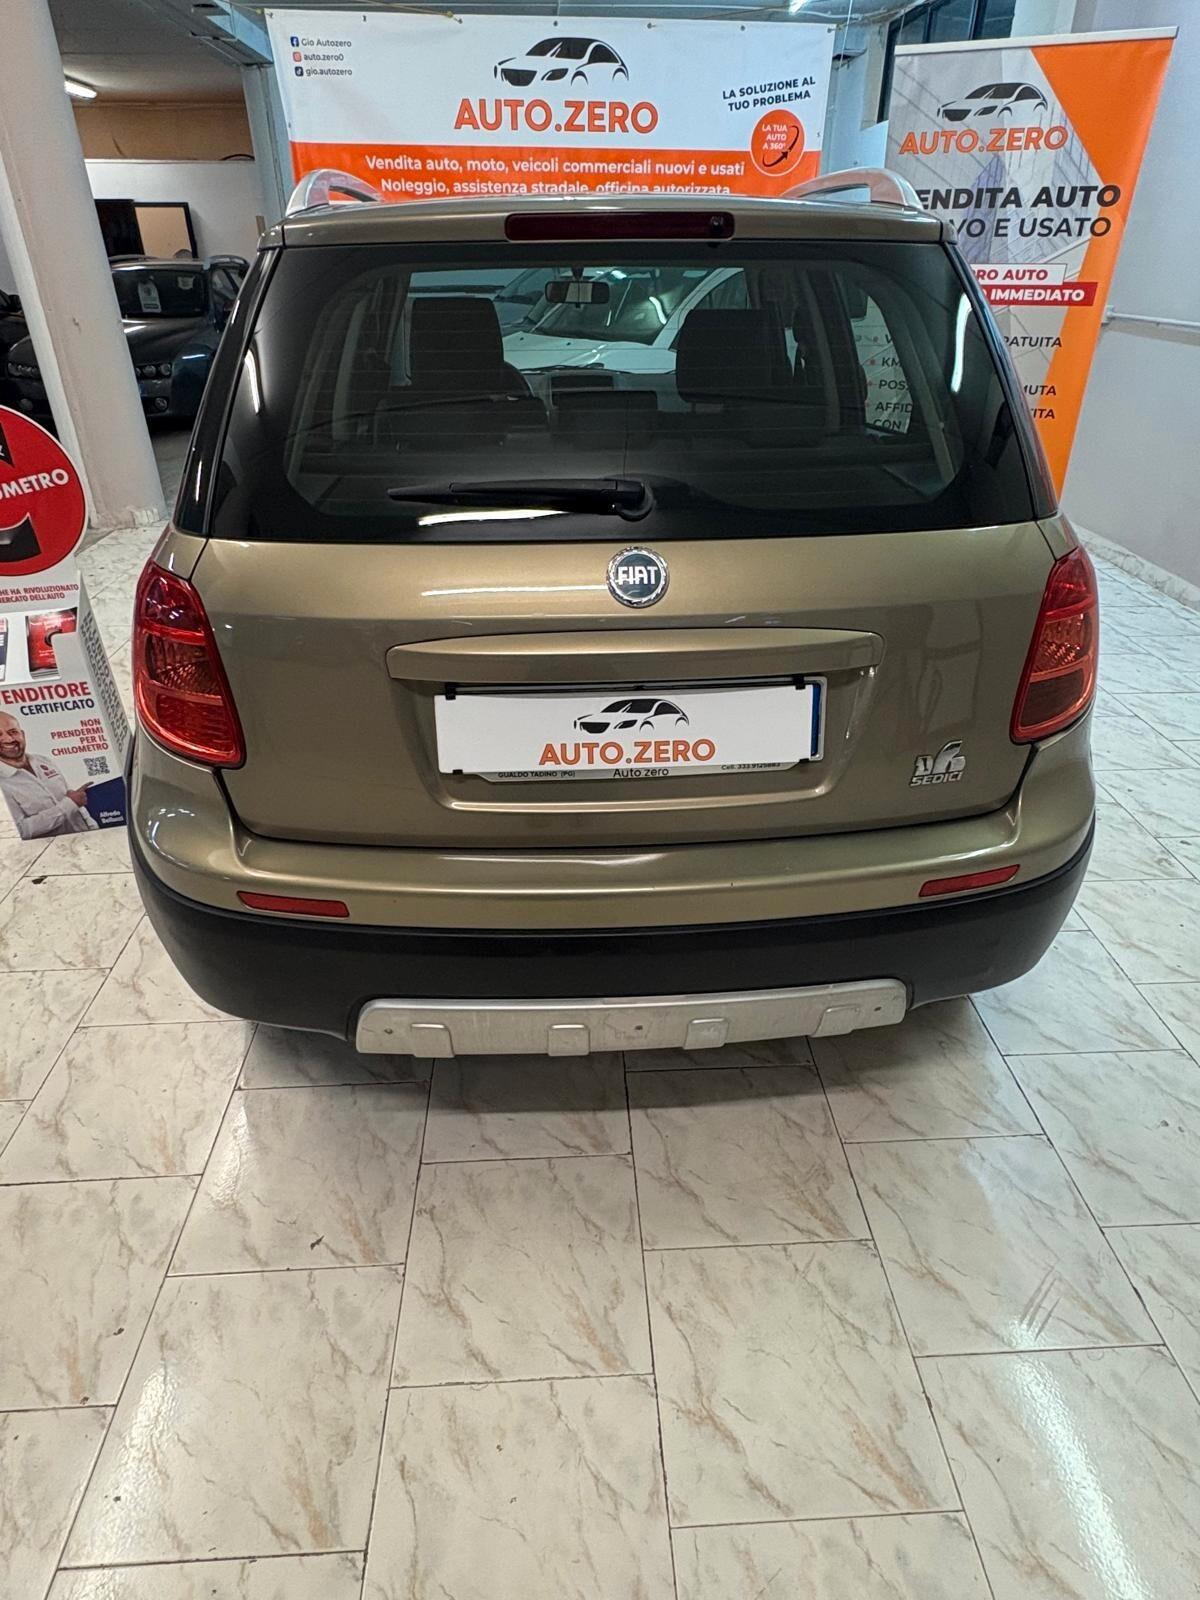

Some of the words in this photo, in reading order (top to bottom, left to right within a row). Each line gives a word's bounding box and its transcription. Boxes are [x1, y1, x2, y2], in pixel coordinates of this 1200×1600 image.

[301, 38, 315, 47] Gio
[316, 39, 352, 48] Autozero
[305, 67, 353, 77] gio.autozero
[723, 90, 736, 100] LA
[739, 79, 799, 97] SOLUZIONE
[802, 76, 816, 87] AL
[728, 100, 750, 111] TUO
[753, 90, 811, 107] PROBLEMA
[454, 98, 659, 134] AUTO.ZERO
[762, 124, 771, 132] LA
[773, 124, 788, 132] TUA
[766, 133, 787, 141] AUTO
[899, 125, 1068, 155] AUTO.ZERO
[763, 142, 769, 150] A
[365, 155, 423, 171] Vendita
[426, 158, 463, 173] auto,
[466, 159, 509, 174] moto,
[512, 157, 559, 173] veicoli
[563, 159, 651, 175] commerciali
[655, 160, 695, 176] nuovi
[698, 166, 707, 175] e
[710, 161, 745, 176] usati
[381, 178, 450, 195] Noleggio,
[453, 180, 528, 194] assistenza
[596, 181, 649, 193] officina
[653, 184, 731, 195] autorizzata
[915, 186, 1023, 211] ENDITA
[1031, 184, 1121, 208] AUTO
[949, 218, 986, 238] VO
[993, 217, 1010, 237] E
[1018, 217, 1112, 237] USATO
[1003, 269, 1049, 281] AUTO
[990, 288, 1085, 302] IMMEDIATO
[879, 379, 909, 391] POS
[875, 402, 913, 414] AFFID
[1031, 408, 1056, 419] ITA
[0, 468, 69, 500] METRO
[615, 566, 658, 585] FIAT
[23, 584, 79, 595] RIVOLUZIONATO
[30, 592, 65, 601] DELL'AUTO
[1, 681, 91, 705] ENDITORE
[20, 698, 95, 716] CERTIFICATO
[80, 718, 101, 728] NON
[50, 727, 104, 740] PRENDERMI
[80, 736, 98, 745] PER
[99, 734, 107, 743] IL
[51, 743, 109, 757] CHILOMETRO
[539, 739, 716, 765] AUTO.ZERO
[613, 768, 642, 778] Auto
[644, 767, 669, 777] zero
[909, 771, 963, 787] SEDICI
